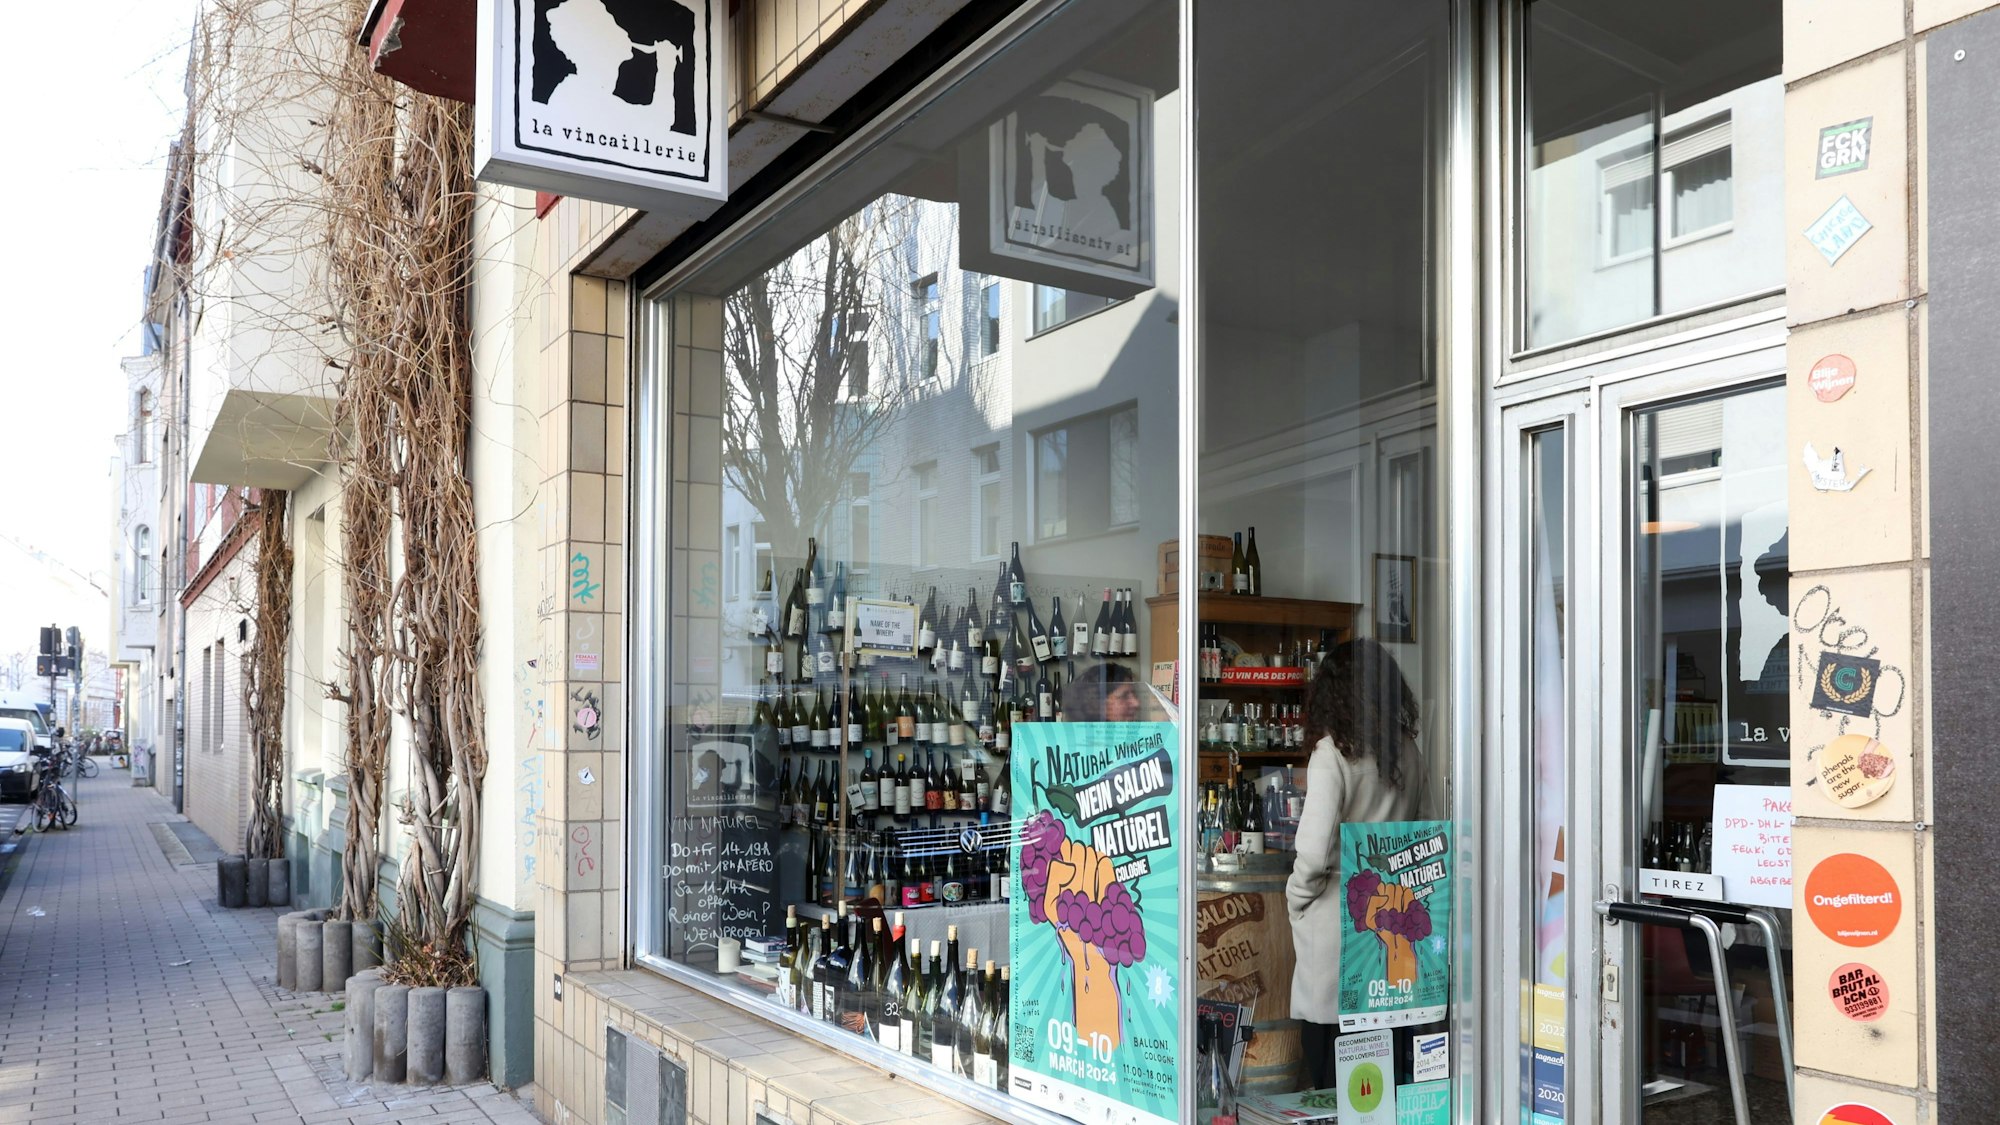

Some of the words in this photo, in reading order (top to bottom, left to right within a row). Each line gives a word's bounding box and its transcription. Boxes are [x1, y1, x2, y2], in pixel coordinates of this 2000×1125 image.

[532, 119, 552, 136] la
[563, 127, 696, 162] vincaillerie
[1822, 128, 1867, 153] FCK
[1821, 143, 1866, 169] GRN
[870, 620, 883, 628] NAME
[891, 621, 901, 629] THE
[876, 629, 894, 637] WINERY
[1221, 671, 1235, 679] DU
[1235, 671, 1252, 680] VIN
[1253, 671, 1269, 680] PAS
[1270, 672, 1286, 680] DES
[1835, 667, 1857, 691] C
[1740, 722, 1768, 742] la
[1821, 754, 1854, 779] phenols
[1826, 774, 1842, 785] are
[1842, 763, 1856, 775] the
[1075, 779, 1112, 821] WEIN
[1114, 757, 1165, 805] SALON
[1832, 778, 1850, 792] new
[1838, 781, 1865, 800] sugar.
[667, 815, 694, 833] VIN
[701, 815, 769, 834] NATUREL
[1093, 811, 1169, 857] NATÜREL
[1388, 849, 1413, 873] WEIN
[1413, 836, 1444, 861] SALON
[1115, 859, 1148, 883] COLOGNE
[1400, 862, 1446, 888] NATÜREL
[675, 880, 693, 897] Sa
[1414, 885, 1434, 900] COLOGNE
[1652, 878, 1705, 892] TIREZ
[698, 895, 735, 908] offen
[1813, 892, 1893, 908] Ongefilterd!
[1197, 940, 1259, 980] ATÜREL
[1839, 969, 1864, 985] BAR
[1832, 975, 1880, 999] BRUTAL
[1368, 996, 1394, 1009] MARCH
[1394, 994, 1414, 1005] 2024
[1338, 1035, 1382, 1047] RECOMMENDED
[1339, 1045, 1367, 1055] NATURAL
[1368, 1042, 1384, 1050] WINE
[1144, 1051, 1174, 1066] COLOGNE
[1339, 1054, 1354, 1063] FOOD
[1355, 1051, 1376, 1060] LOVERS
[1050, 1052, 1085, 1079] MARCH
[1086, 1063, 1117, 1085] 2024
[1399, 1093, 1437, 1112] UTOPIA
[1538, 1088, 1565, 1103] 2020
